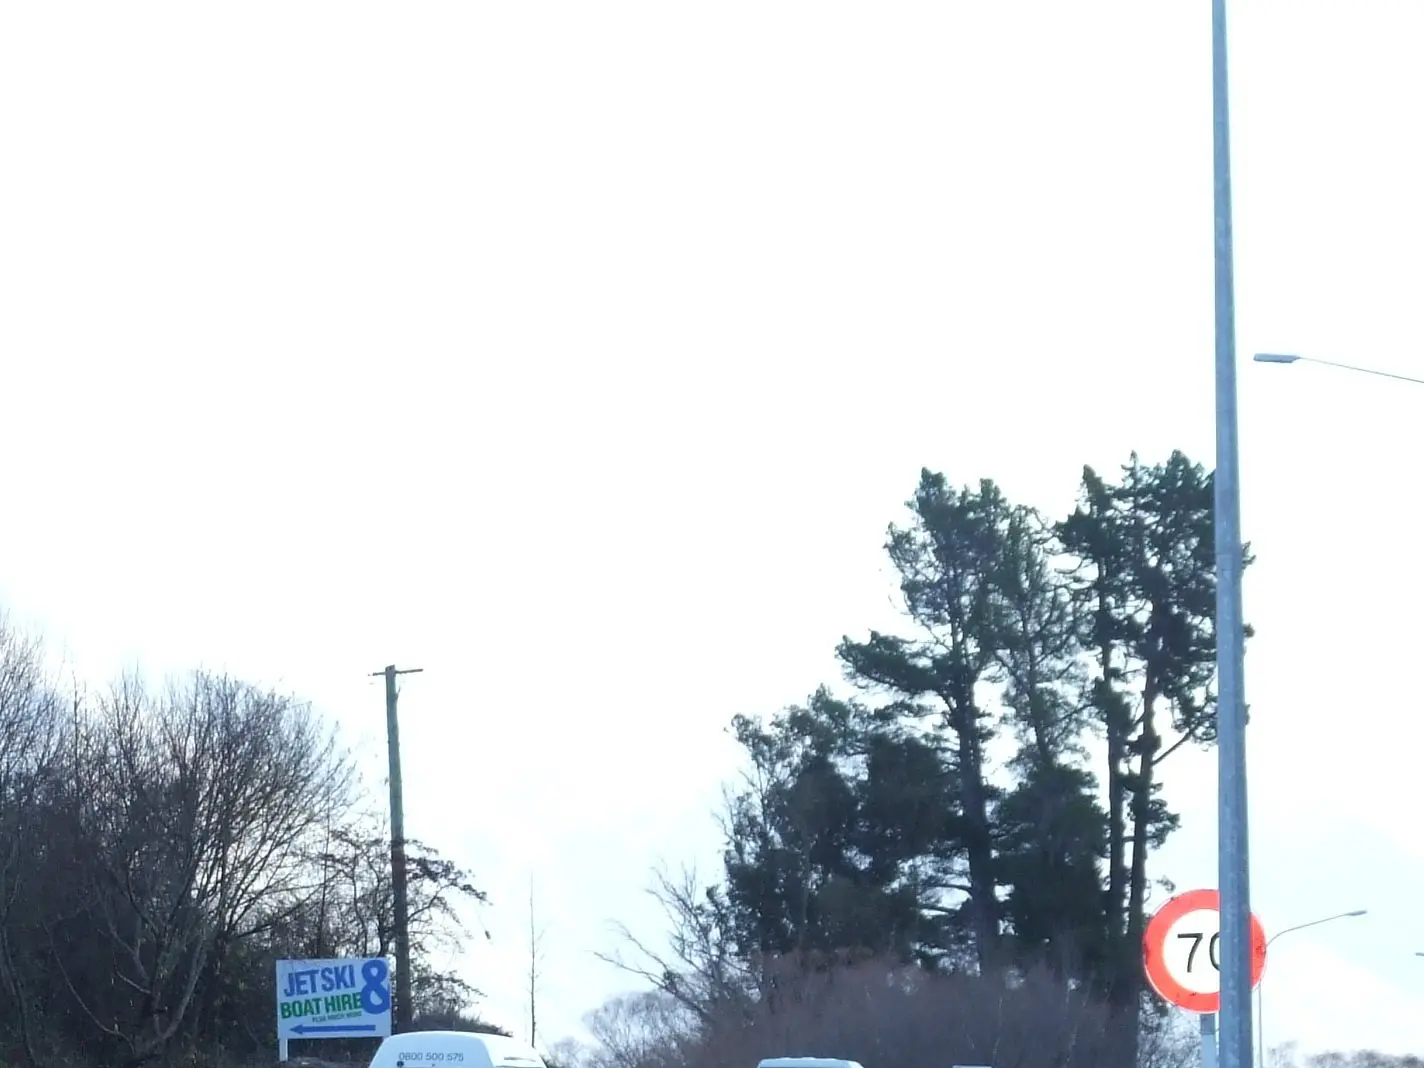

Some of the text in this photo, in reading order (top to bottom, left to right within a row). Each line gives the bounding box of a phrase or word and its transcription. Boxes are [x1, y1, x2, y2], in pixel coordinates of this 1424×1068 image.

[280, 992, 362, 1019] BOAT HIRE
[398, 1052, 464, 1062] 0800 500 575
